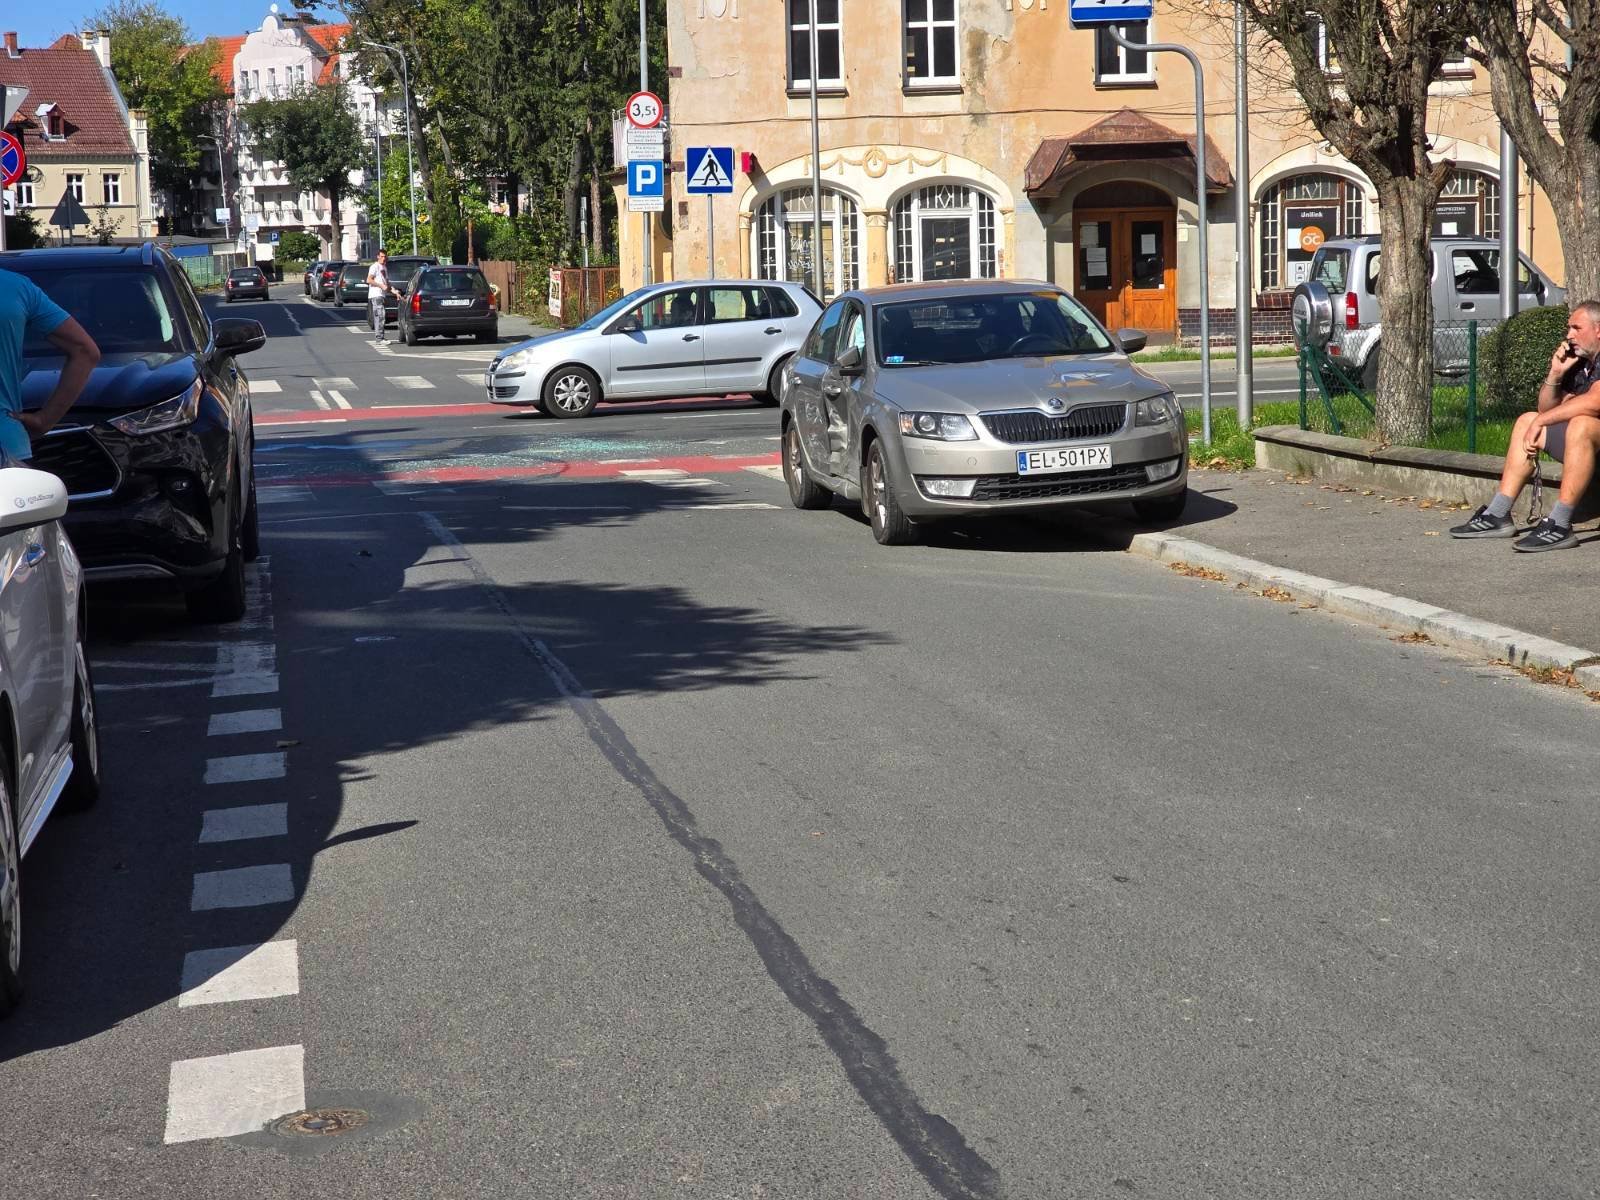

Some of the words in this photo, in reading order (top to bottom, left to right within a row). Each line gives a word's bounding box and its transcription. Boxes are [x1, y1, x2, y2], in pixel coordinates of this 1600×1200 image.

[636, 164, 656, 193] P
[271, 232, 278, 241] P
[1302, 235, 1321, 246] OC
[1029, 452, 1052, 469] EL
[1058, 448, 1107, 466] 501PX
